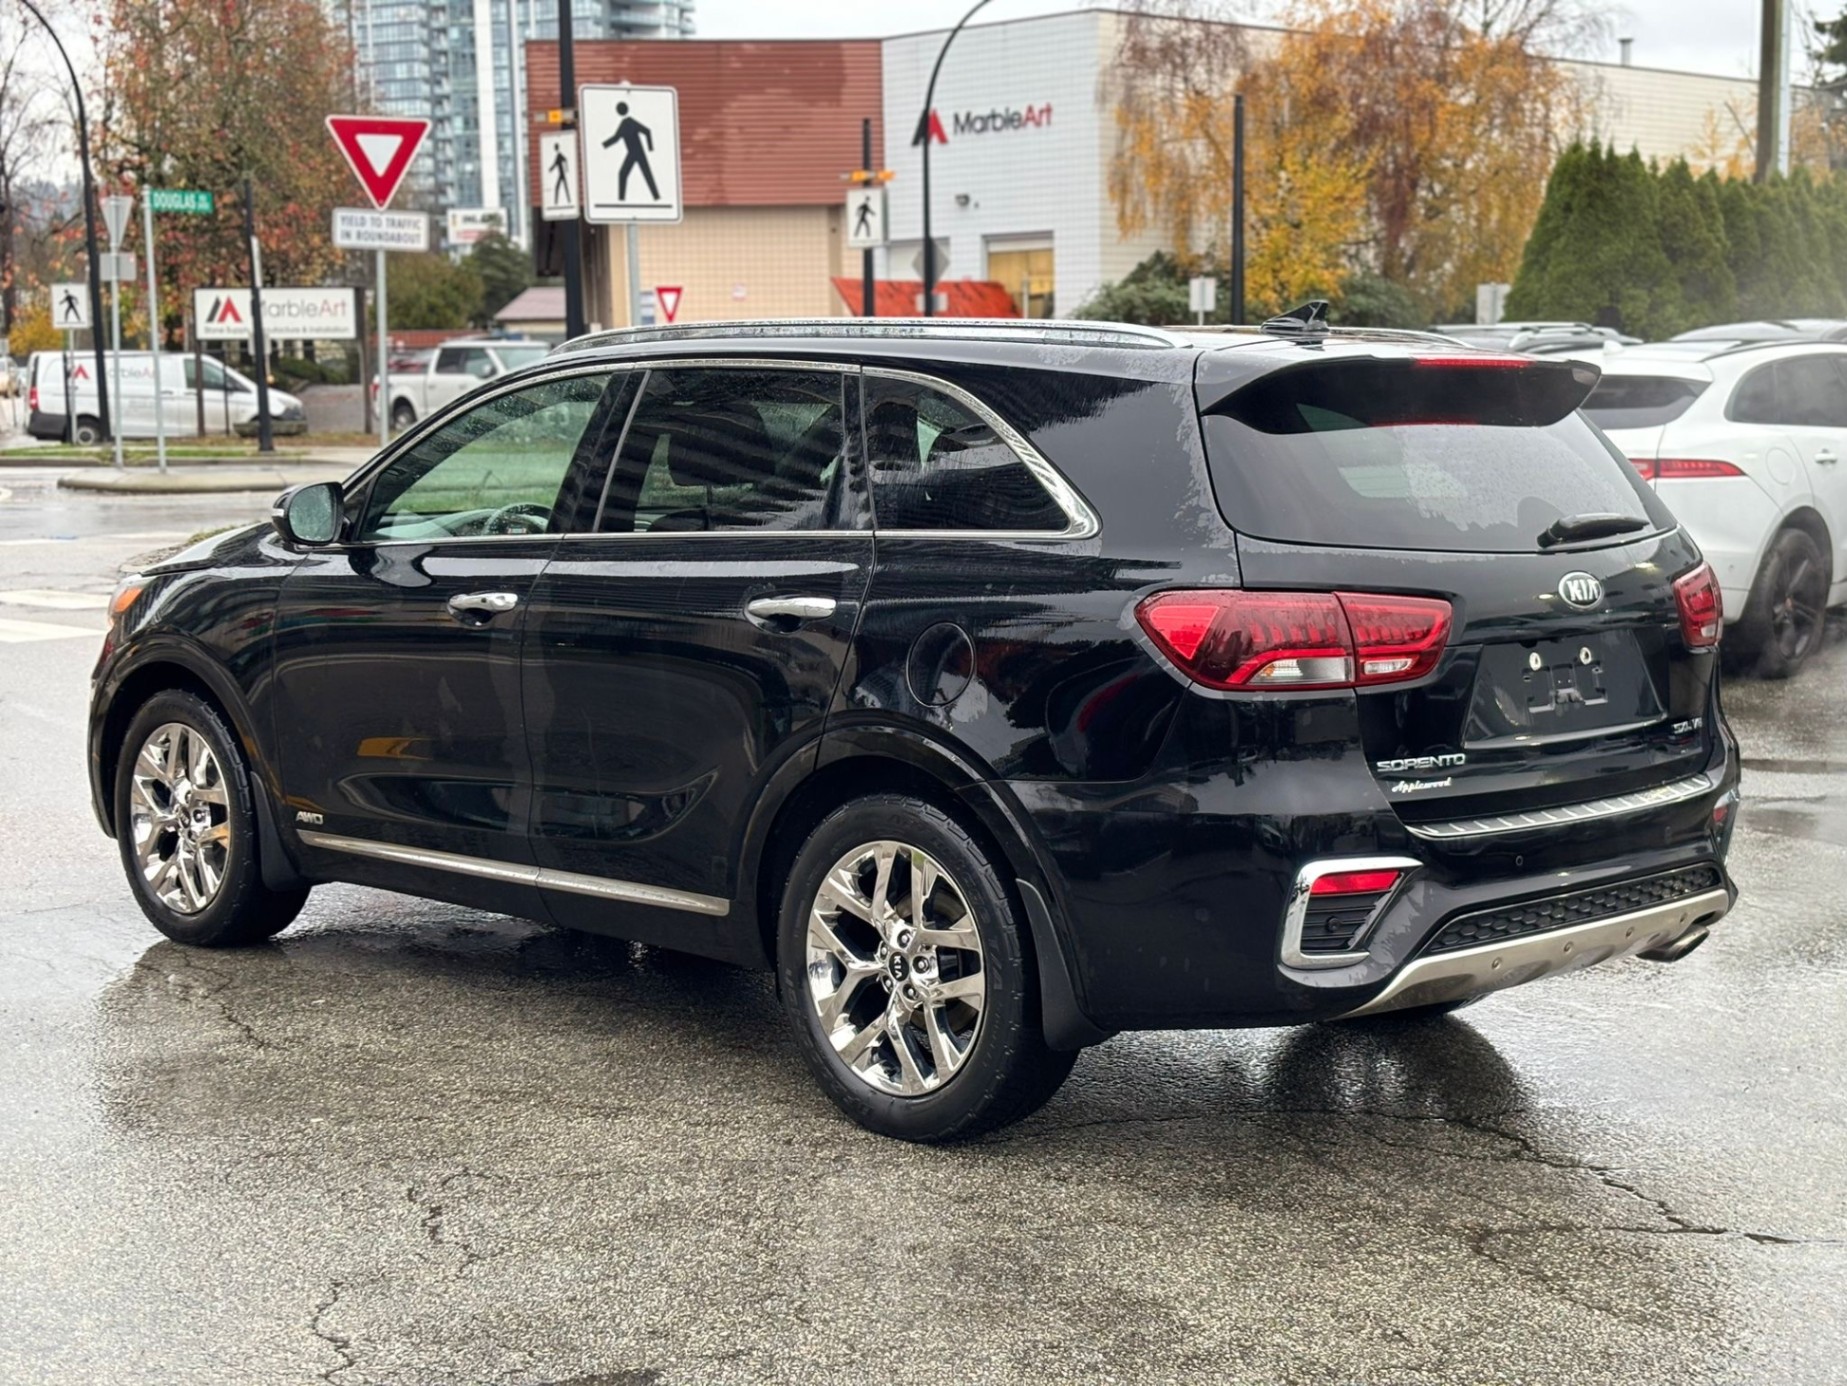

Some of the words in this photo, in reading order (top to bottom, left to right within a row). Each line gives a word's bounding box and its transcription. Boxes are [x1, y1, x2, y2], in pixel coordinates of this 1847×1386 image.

[953, 102, 1053, 135] MarbleArt
[153, 191, 196, 209] DOUGLAS
[340, 214, 366, 228] YIELD
[370, 215, 382, 229] TO
[386, 216, 421, 230] TRAFFIC
[340, 229, 352, 241] IN
[356, 230, 421, 244] ROUNDABOUT
[1566, 579, 1599, 601] KIA
[1376, 753, 1466, 772] SORENTO
[295, 810, 324, 825] AWD
[893, 955, 903, 979] KIA
